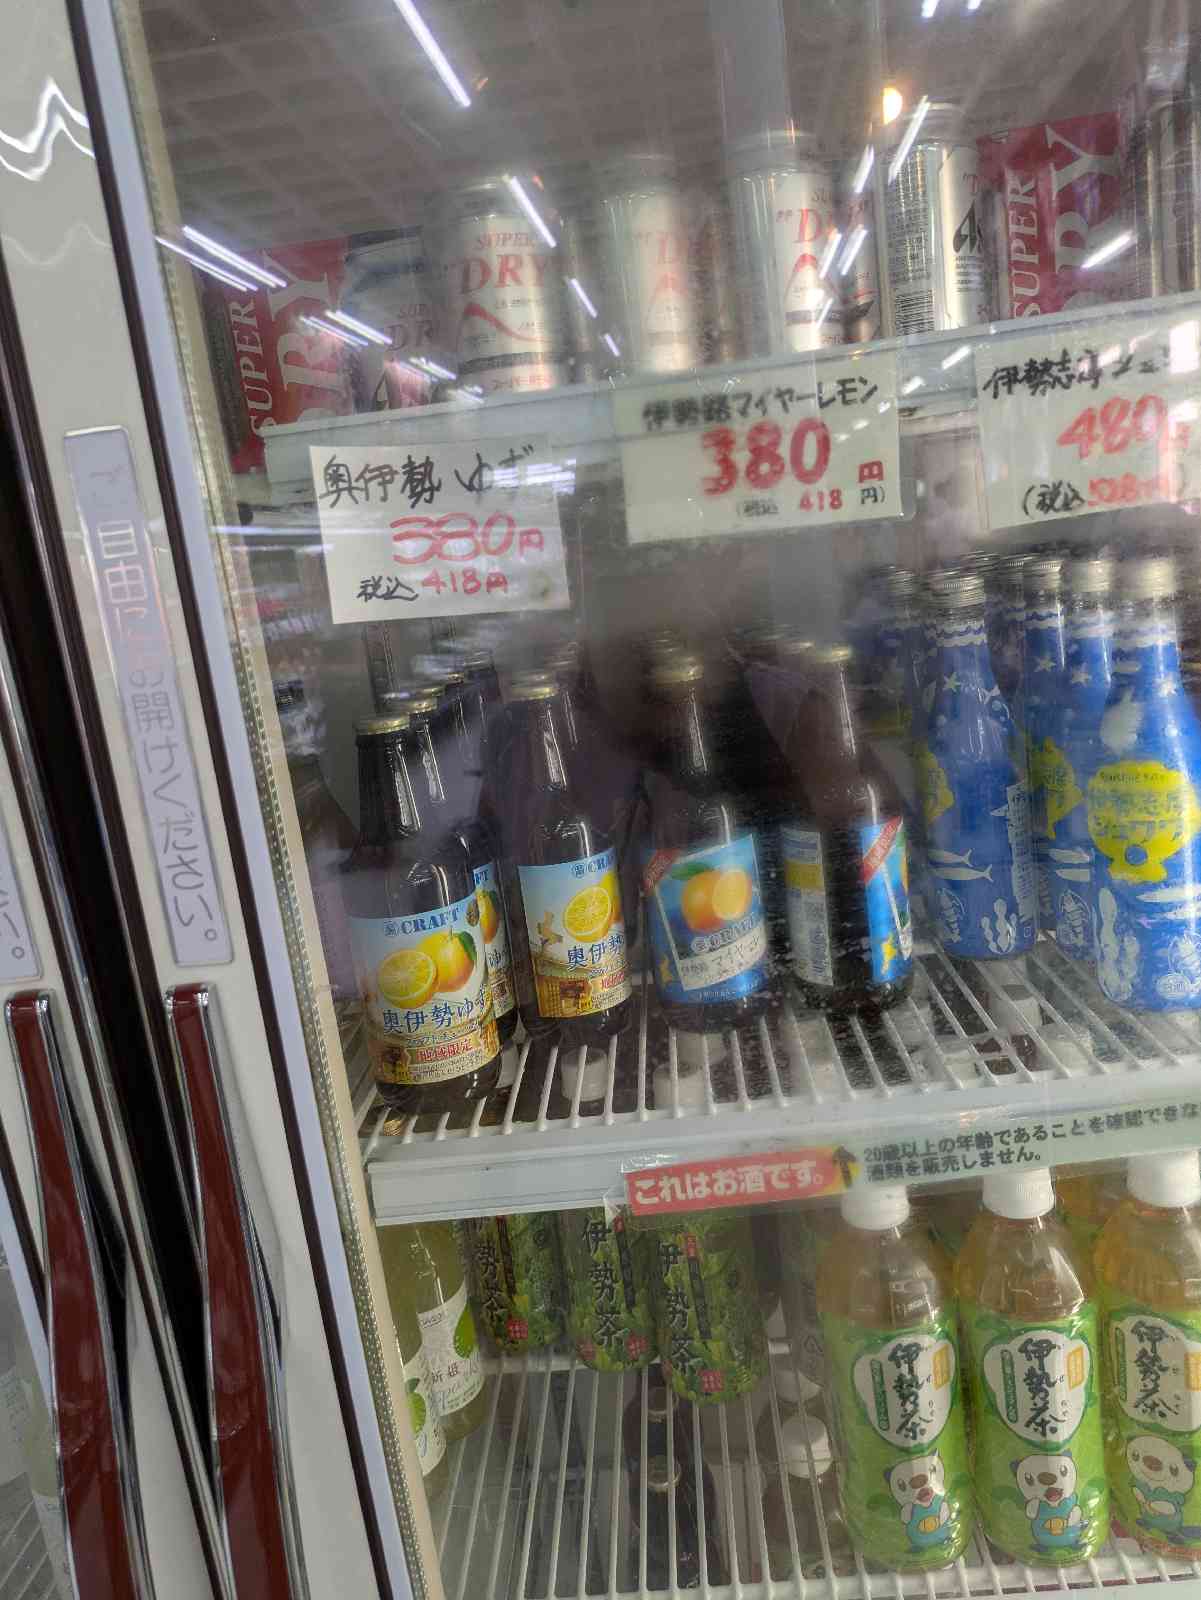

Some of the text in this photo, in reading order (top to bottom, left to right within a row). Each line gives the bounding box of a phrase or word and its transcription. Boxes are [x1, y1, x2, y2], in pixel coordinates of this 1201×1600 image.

[1004, 167, 1041, 319] SUPER
[230, 299, 278, 438] SUPER
[703, 417, 831, 497] 380
[357, 575, 419, 602] 税込
[401, 907, 460, 934] CRAFT
[635, 1159, 823, 1205] これはお酒です。
